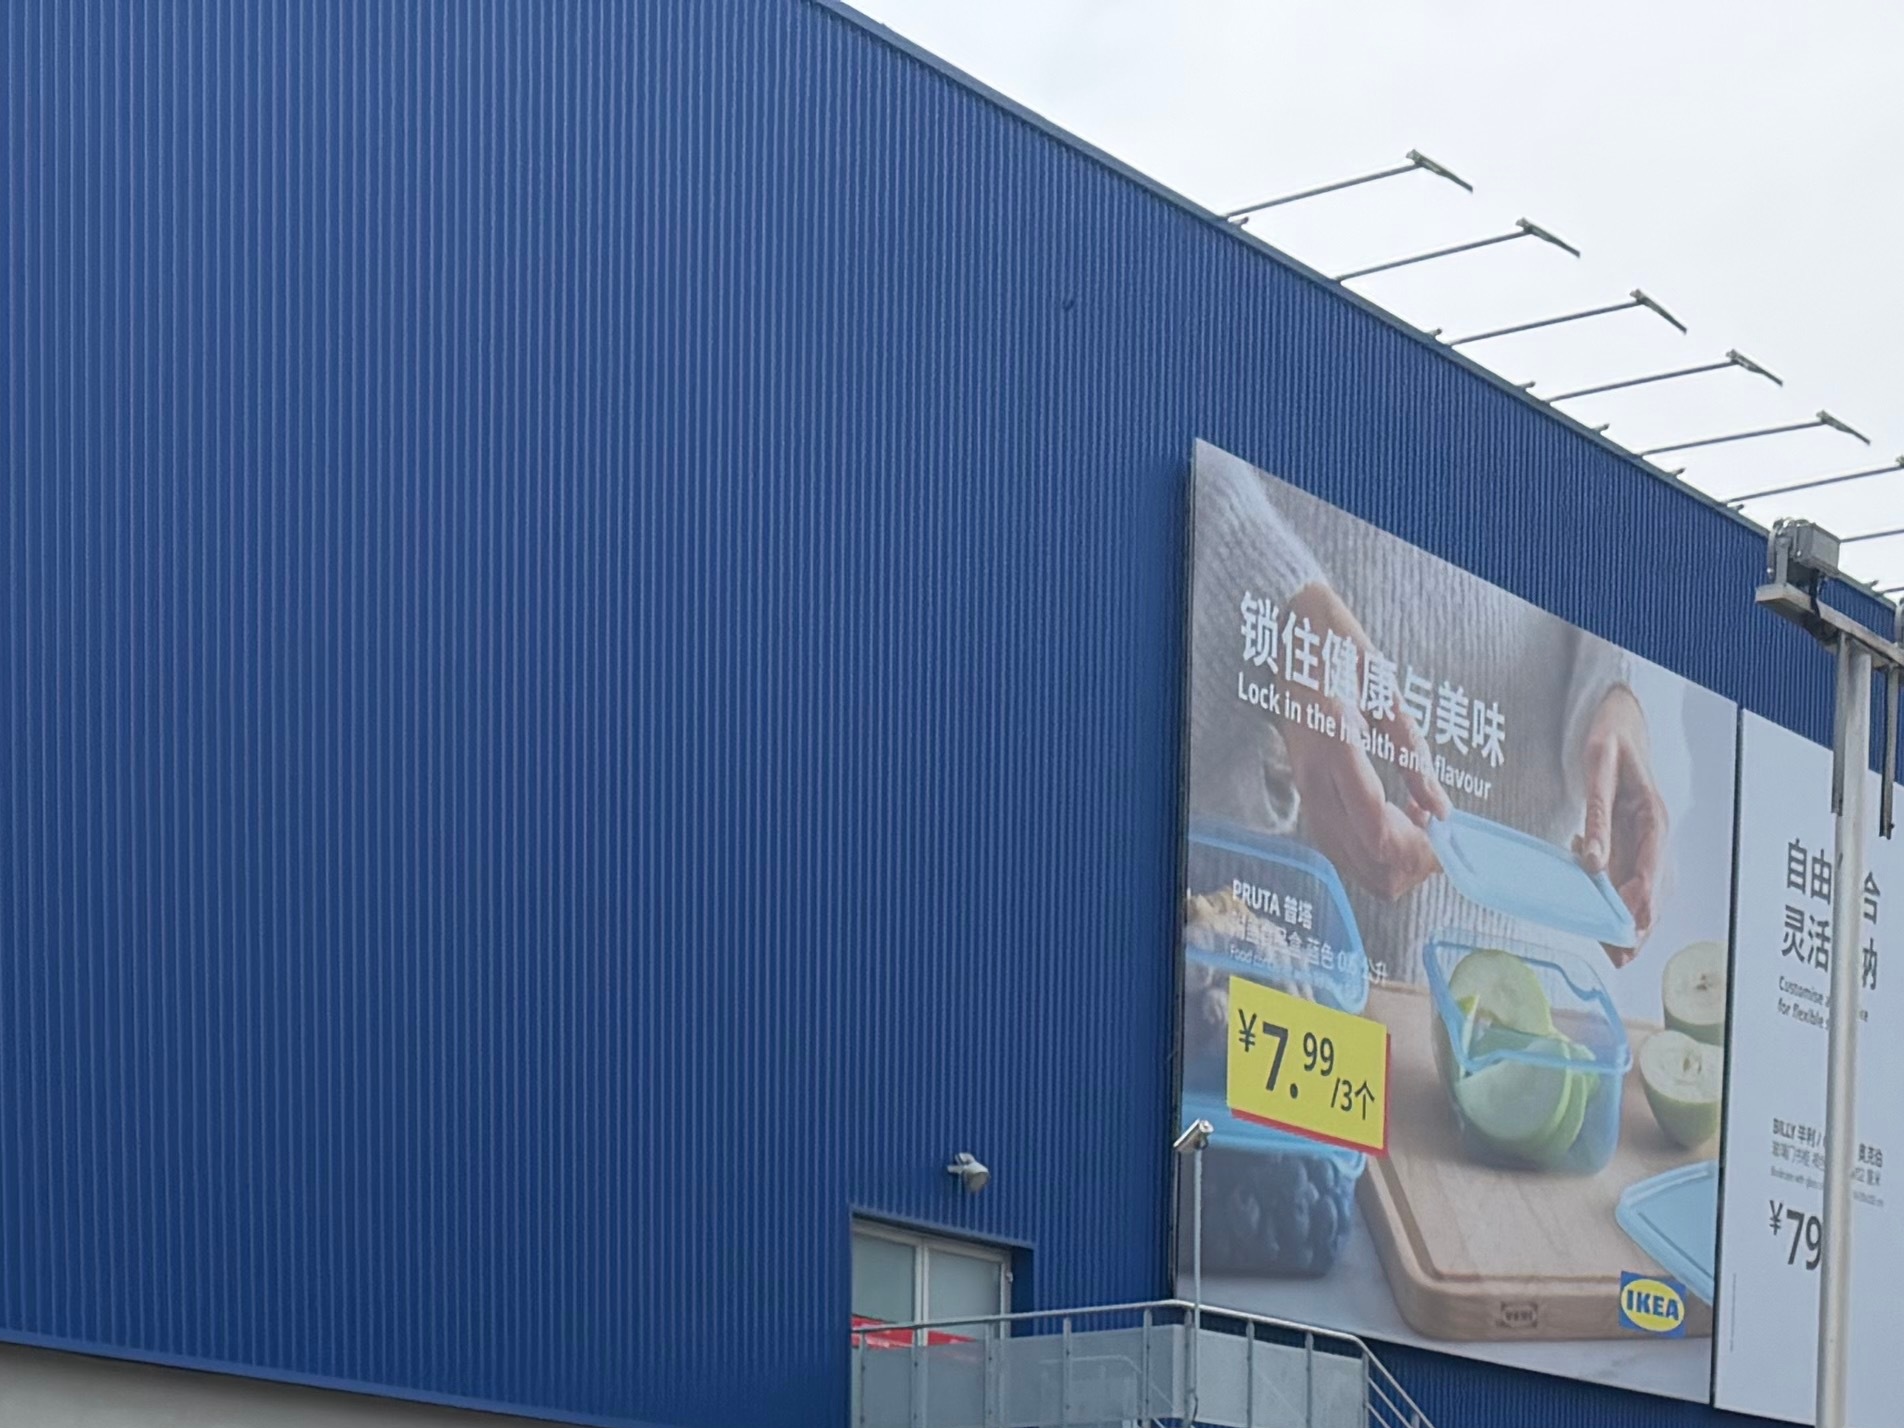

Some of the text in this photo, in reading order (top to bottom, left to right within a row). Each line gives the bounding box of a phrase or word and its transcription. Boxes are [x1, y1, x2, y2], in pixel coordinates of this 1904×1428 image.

[1240, 590, 1507, 769] 锁住健康与美味
[1237, 671, 1280, 715] Lock
[1284, 691, 1302, 725] in
[1306, 702, 1337, 738] the
[1340, 718, 1395, 764] halth
[1434, 757, 1492, 801] flavour
[1232, 878, 1313, 931] PRUTA 普塔
[1786, 837, 1881, 925] 自由合
[1781, 904, 1879, 990] 灵活纳
[1626, 1289, 1680, 1321] IKEA
